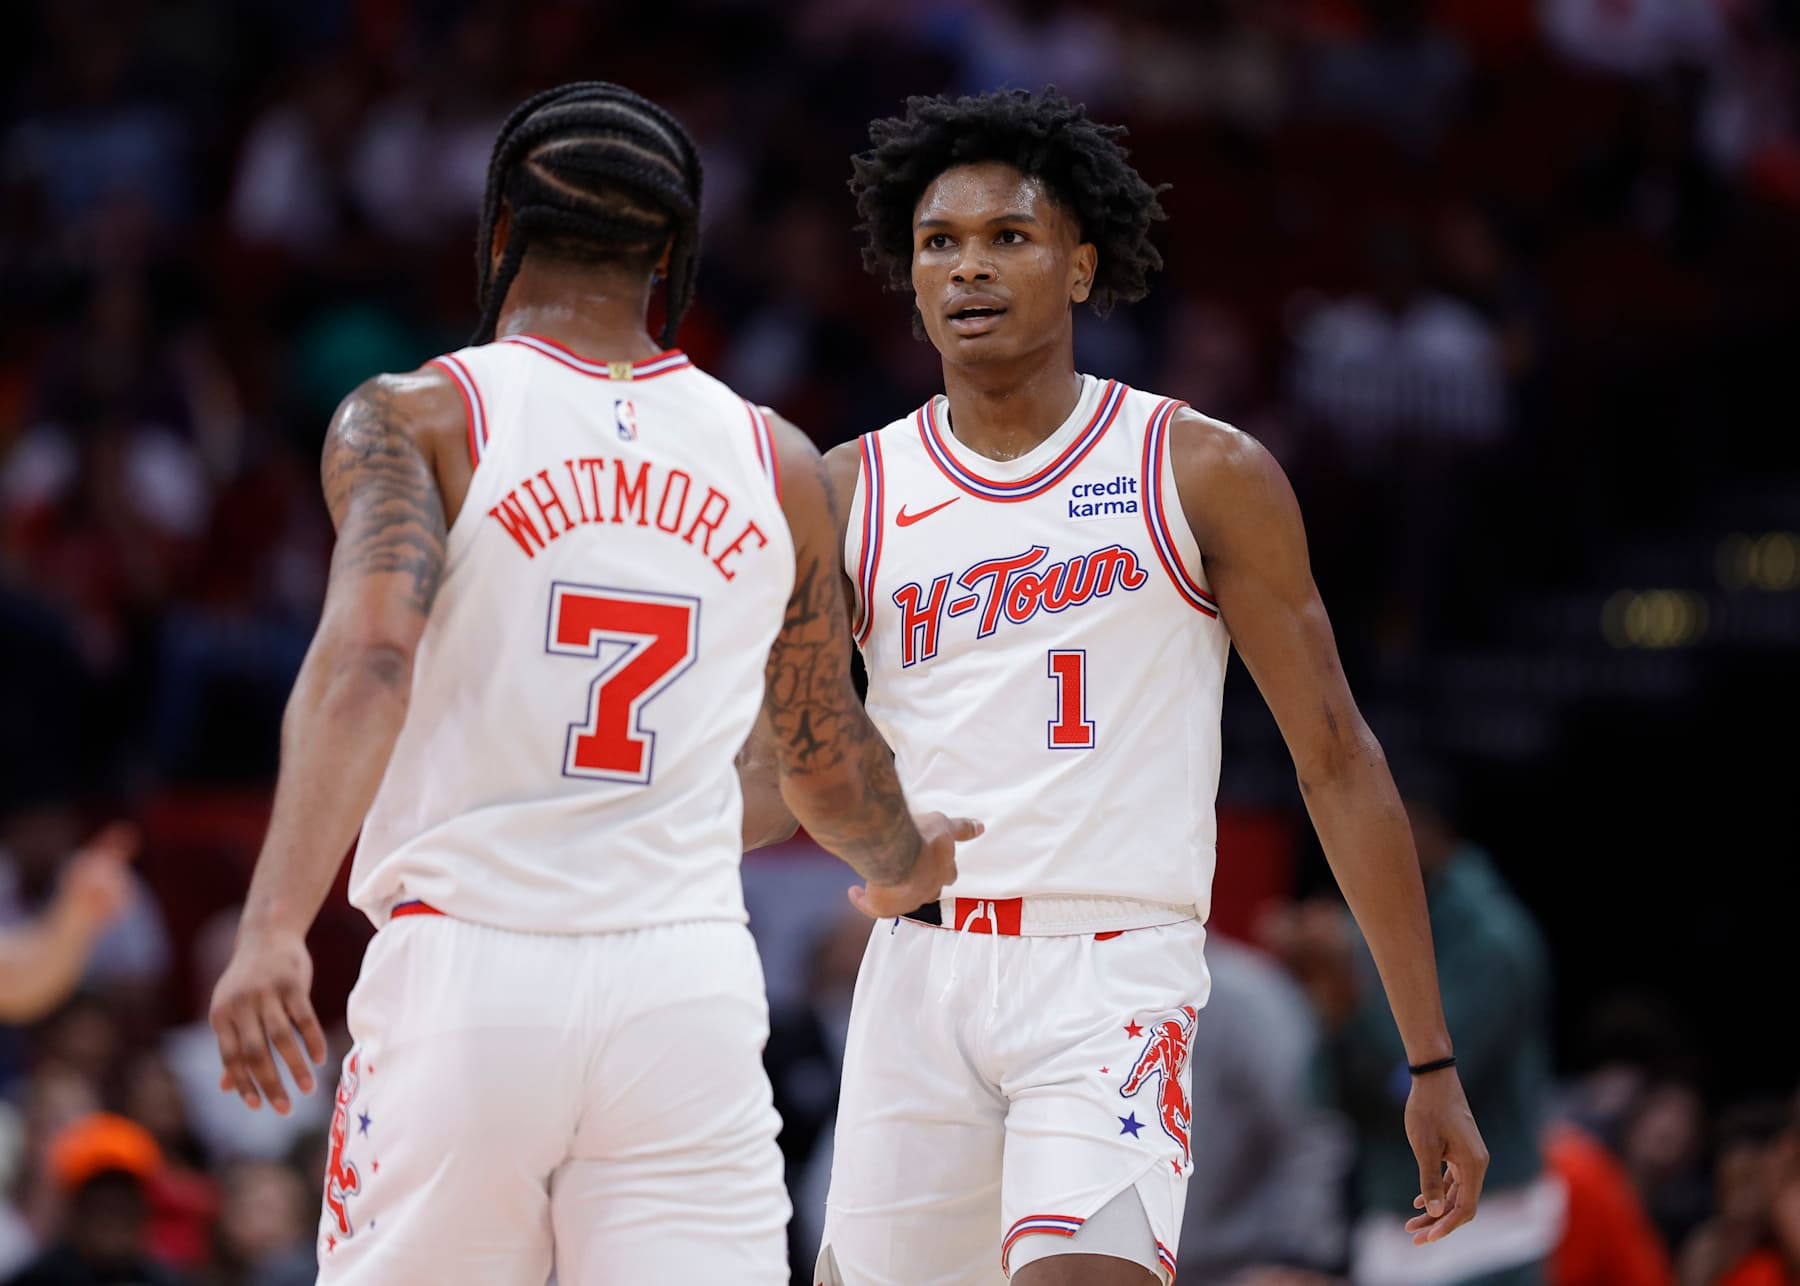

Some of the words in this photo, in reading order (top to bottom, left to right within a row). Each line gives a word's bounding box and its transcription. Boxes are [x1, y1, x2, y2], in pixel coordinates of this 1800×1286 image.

[488, 457, 768, 582] WHITMORE
[1069, 500, 1138, 518] karma
[1072, 477, 1137, 498] credit
[892, 544, 1148, 668] H-Town
[545, 581, 701, 785] 7
[1048, 649, 1095, 749] 1
